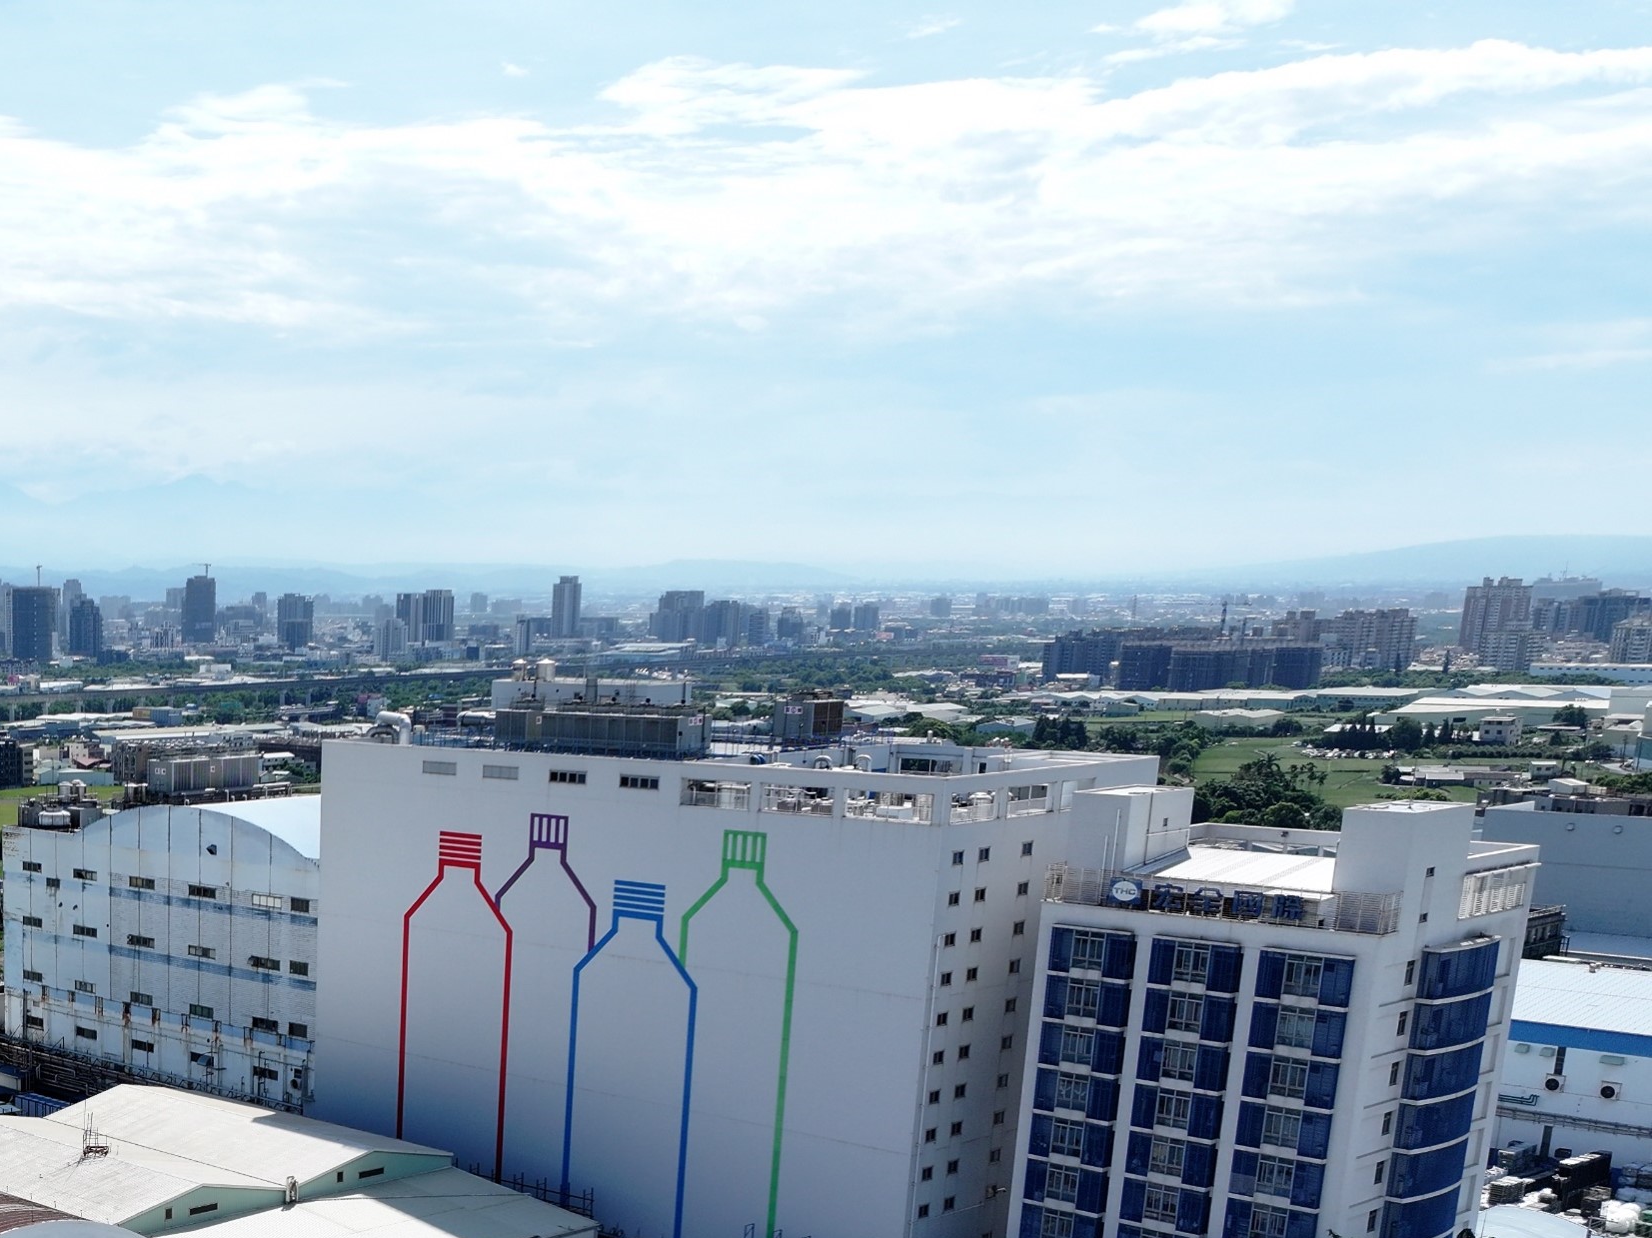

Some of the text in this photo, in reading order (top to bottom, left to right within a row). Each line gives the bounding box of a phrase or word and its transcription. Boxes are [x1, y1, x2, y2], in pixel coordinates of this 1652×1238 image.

[1113, 887, 1137, 896] THC
[1153, 883, 1307, 920] 宏全國際
